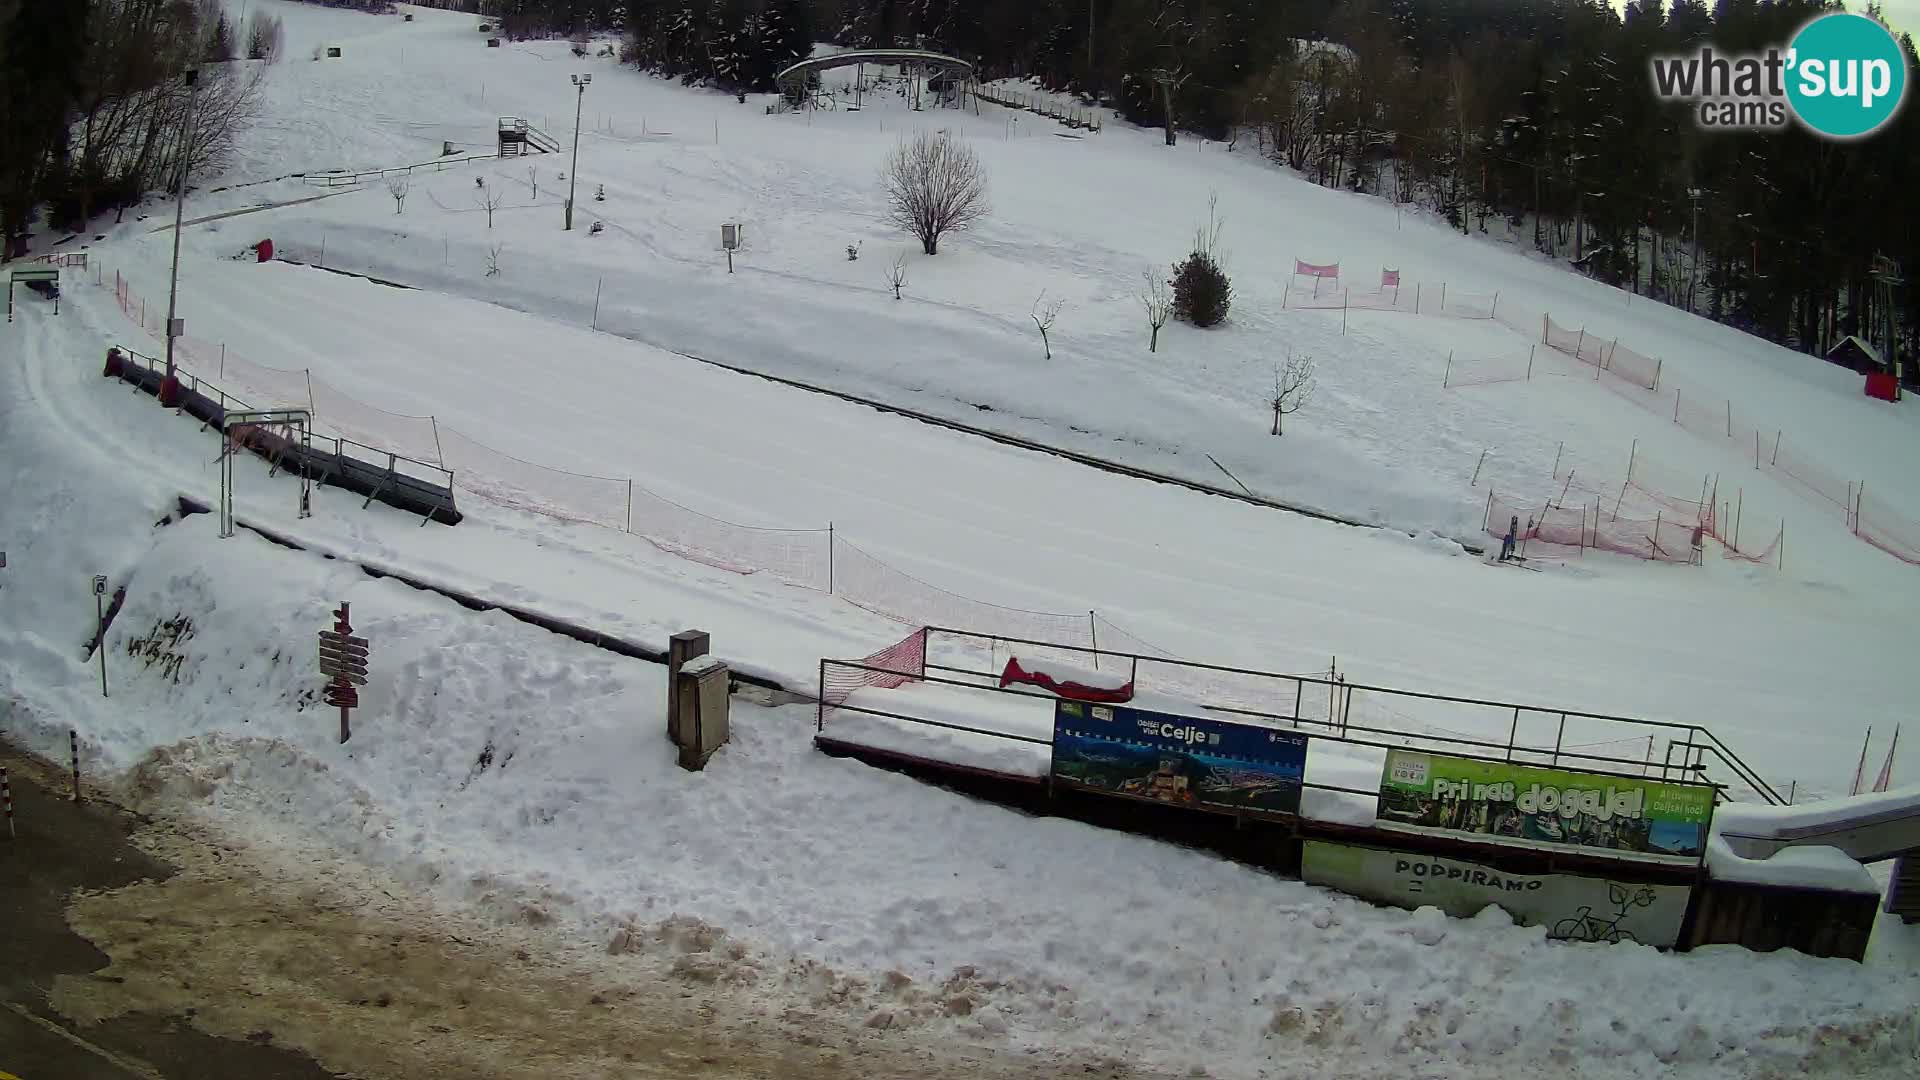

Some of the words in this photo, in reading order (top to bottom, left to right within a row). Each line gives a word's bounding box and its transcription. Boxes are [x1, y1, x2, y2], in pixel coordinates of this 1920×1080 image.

[1160, 723, 1206, 745] Celje
[1432, 777, 1469, 801] Pri
[1472, 782, 1515, 802] nas
[1395, 859, 1543, 891] PODPIRAMO
